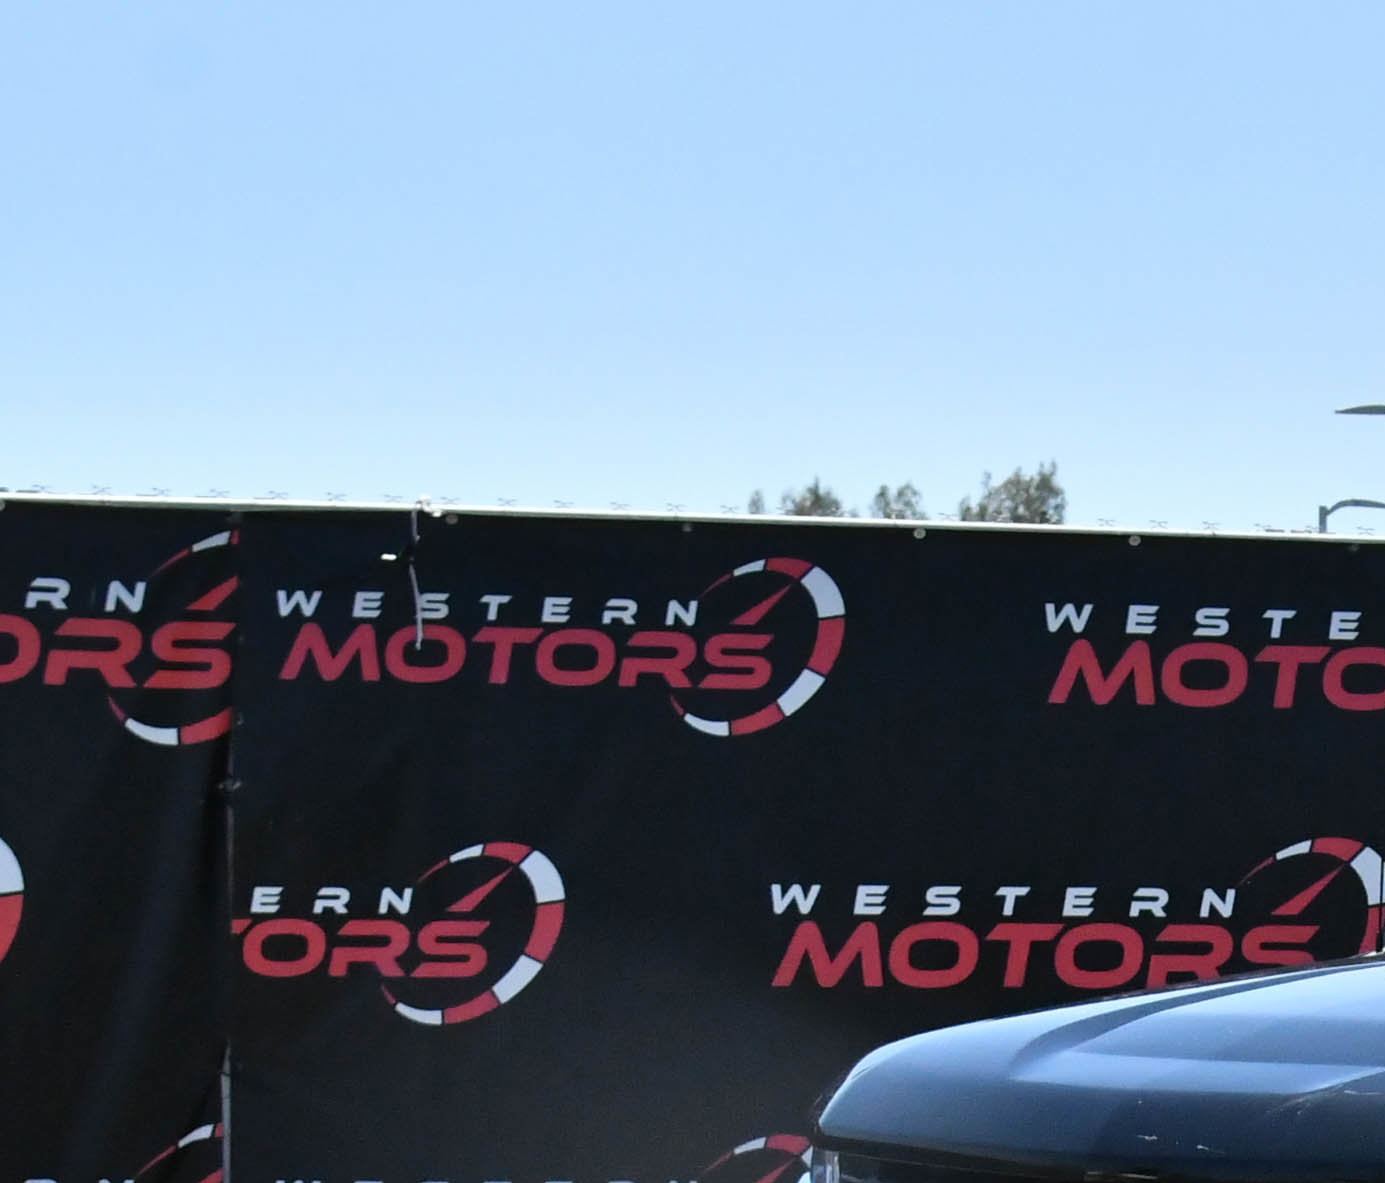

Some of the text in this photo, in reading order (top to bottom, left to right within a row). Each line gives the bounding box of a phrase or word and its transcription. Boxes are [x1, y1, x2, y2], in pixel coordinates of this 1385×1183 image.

[277, 589, 698, 627] WESTERN
[279, 622, 773, 690] MOTORS
[771, 883, 1236, 919] WESTERN
[771, 921, 1320, 990] MOTORS
